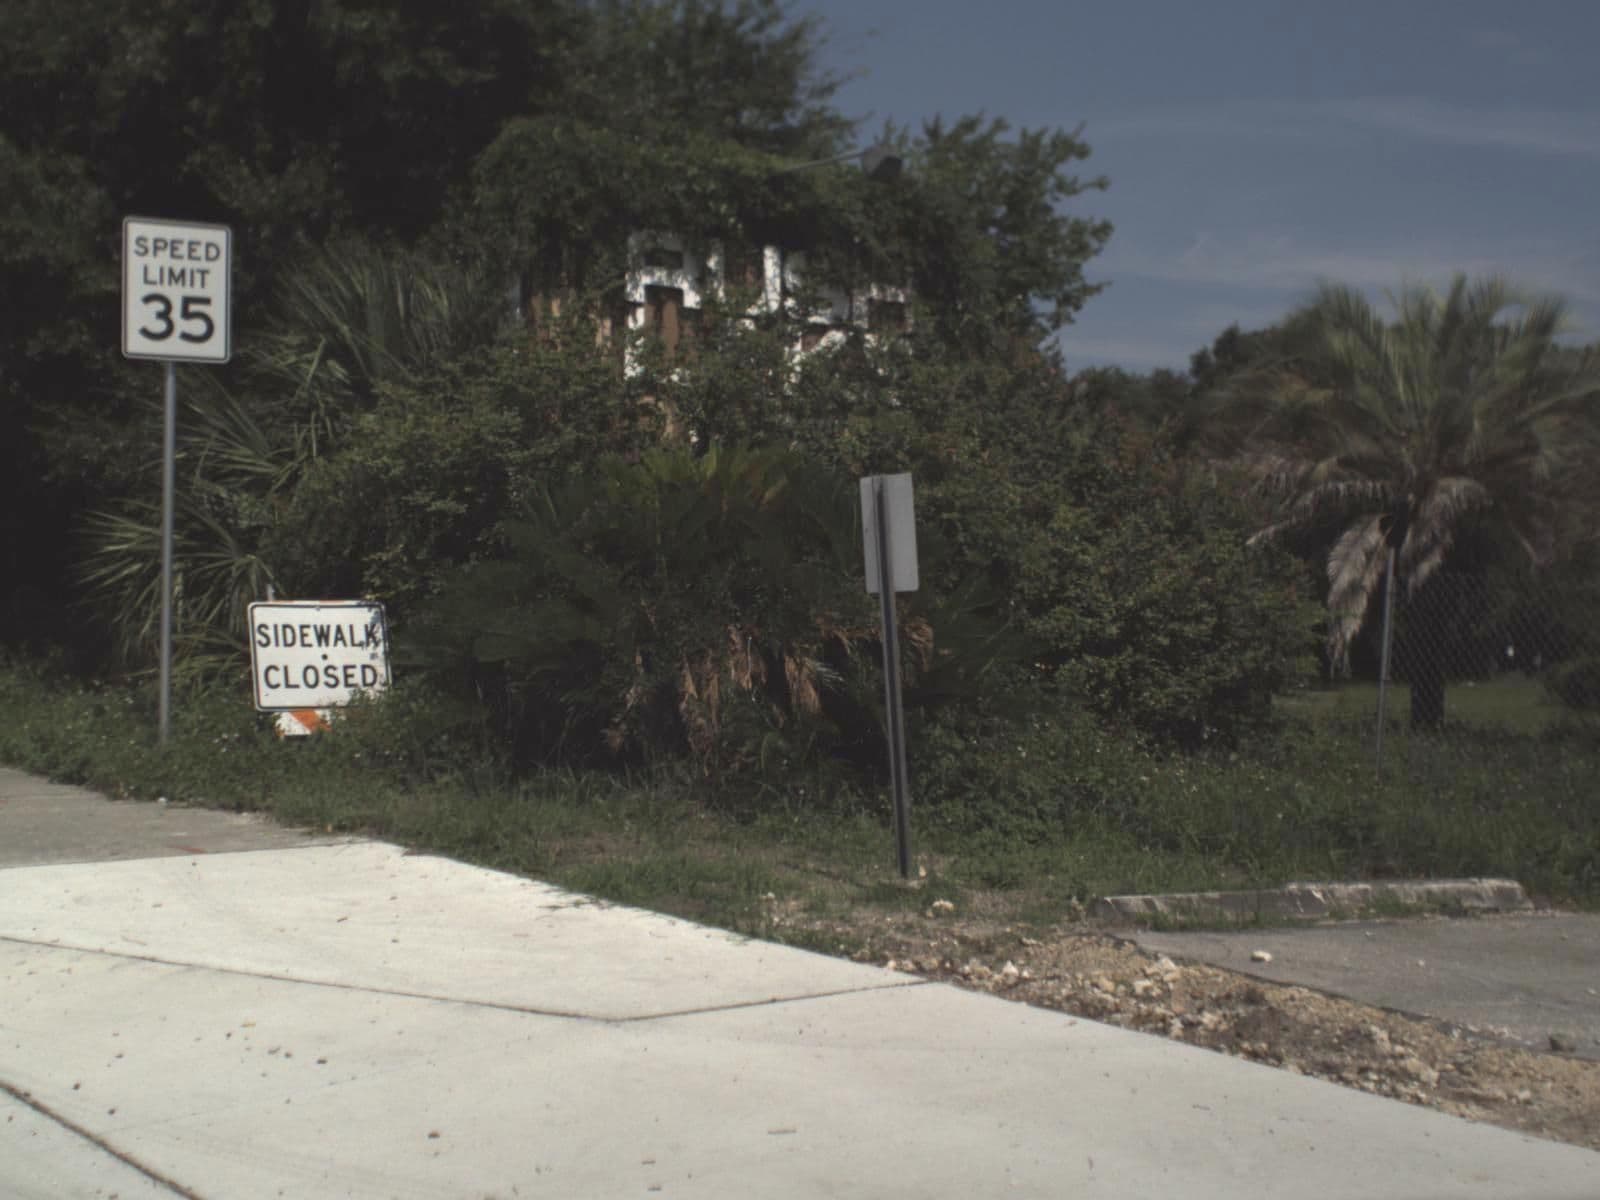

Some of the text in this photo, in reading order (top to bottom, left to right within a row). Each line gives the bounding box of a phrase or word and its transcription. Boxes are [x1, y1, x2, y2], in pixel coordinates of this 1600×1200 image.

[134, 236, 220, 262] SPEED
[143, 265, 210, 288] LIMIT
[139, 293, 214, 343] 35
[256, 624, 380, 648] SIDEWALK
[264, 664, 377, 689] CLOSED
